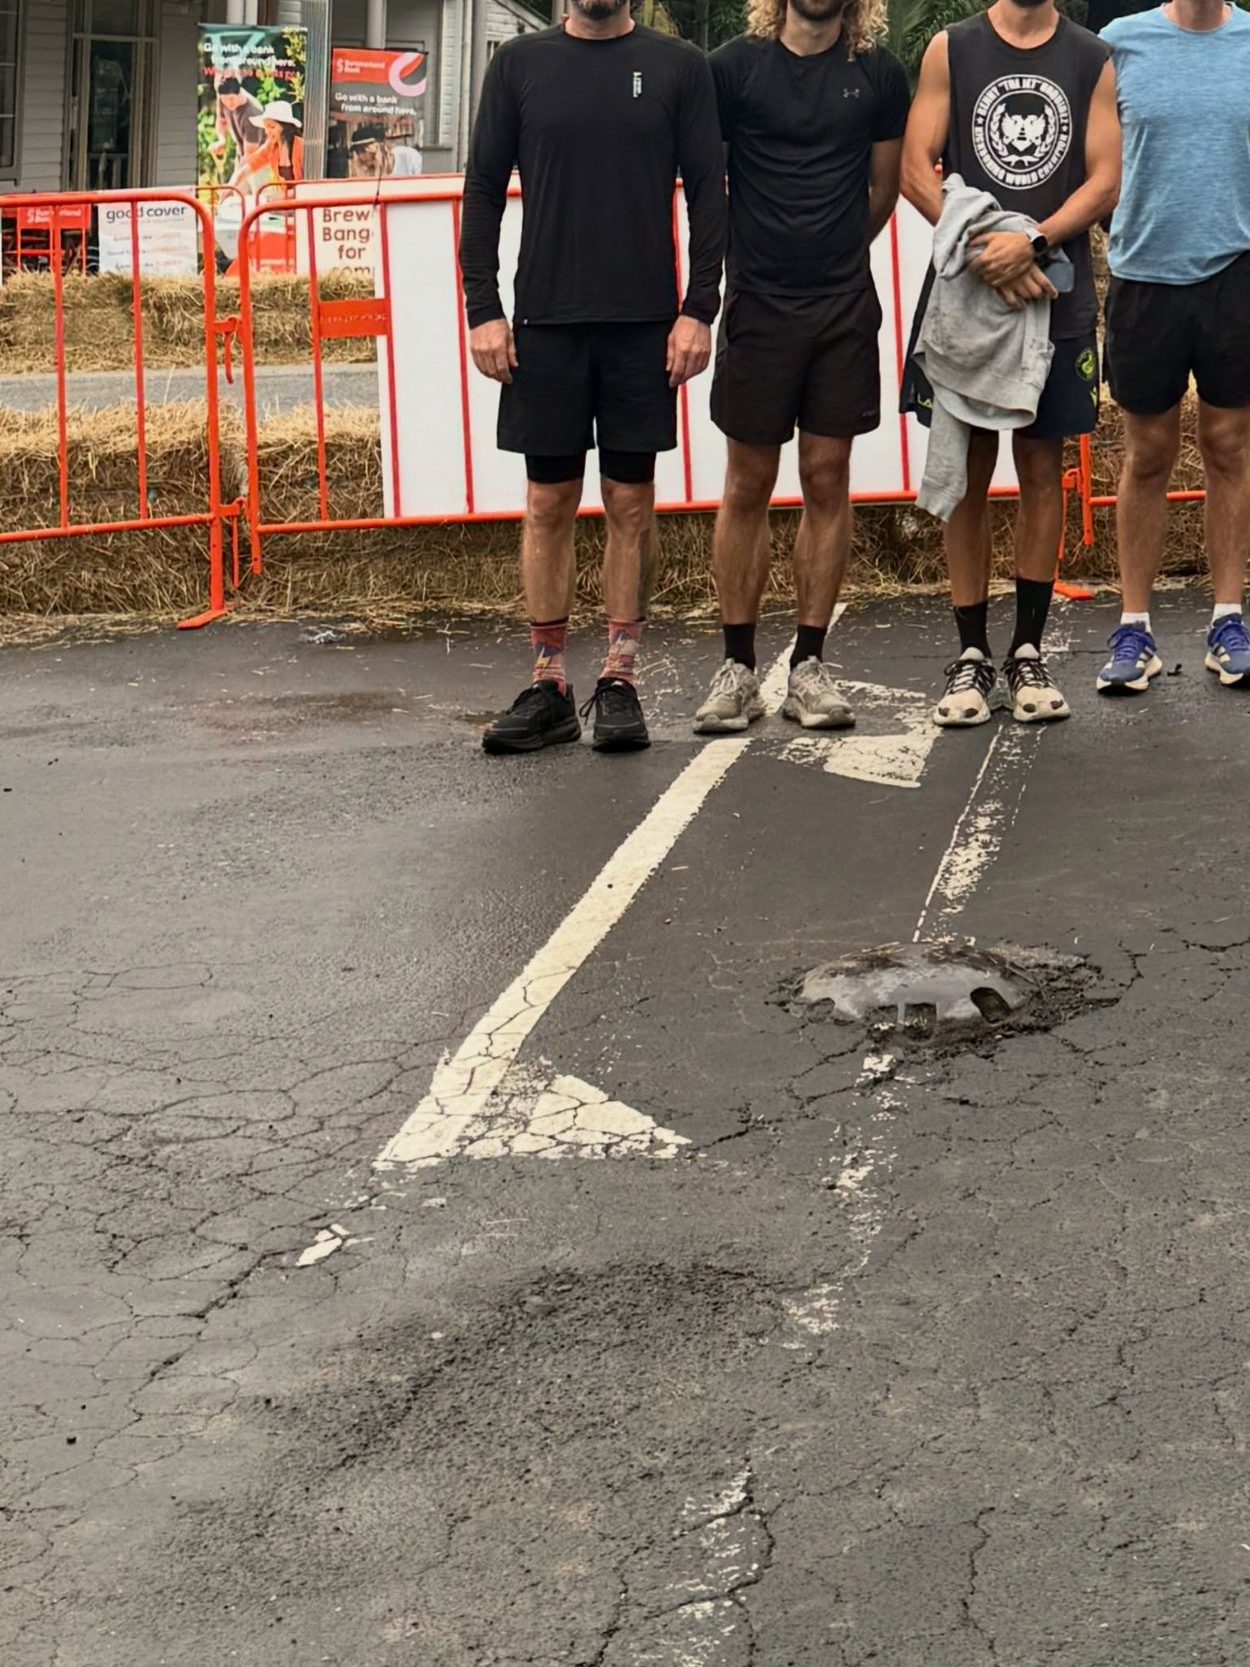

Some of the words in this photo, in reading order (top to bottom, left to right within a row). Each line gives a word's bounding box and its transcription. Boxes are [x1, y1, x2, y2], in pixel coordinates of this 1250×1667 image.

[335, 92, 348, 102] Go
[349, 94, 368, 103] with
[376, 95, 398, 104] bank
[341, 103, 362, 113] from
[362, 104, 395, 115] around
[106, 205, 144, 224] good
[146, 206, 187, 218] cover
[322, 226, 374, 244] Bang
[338, 244, 366, 260] for
